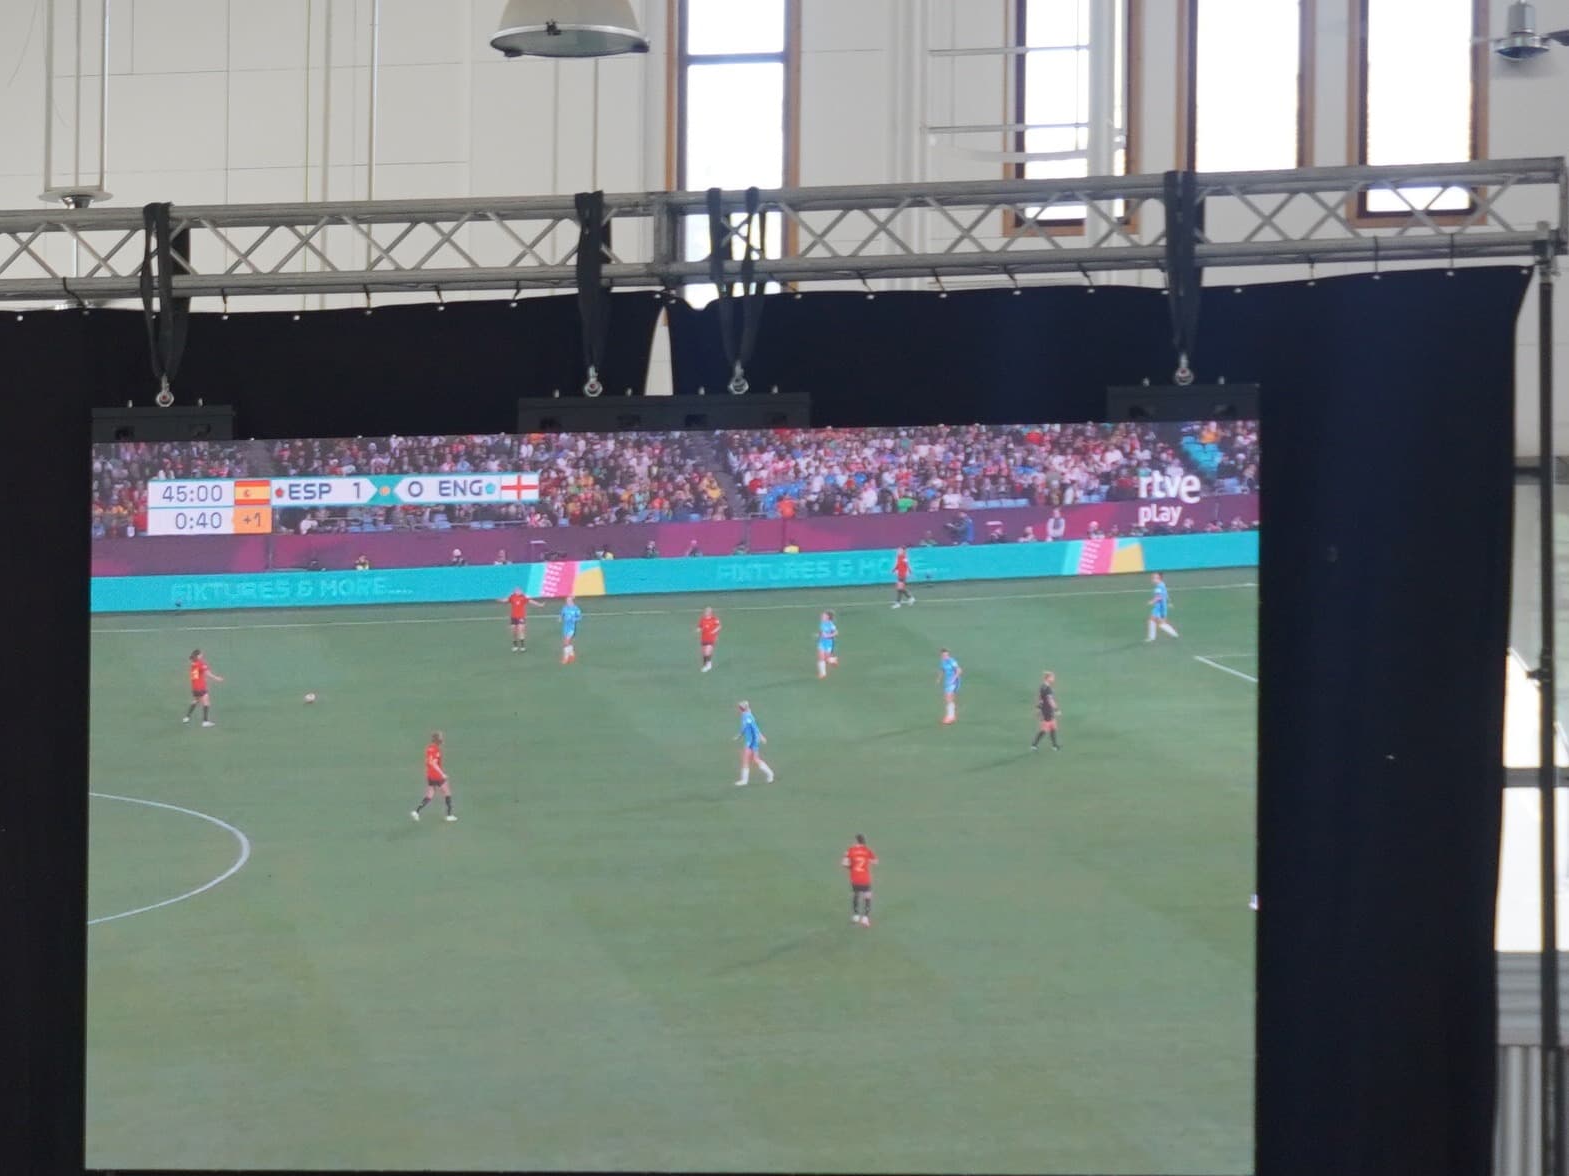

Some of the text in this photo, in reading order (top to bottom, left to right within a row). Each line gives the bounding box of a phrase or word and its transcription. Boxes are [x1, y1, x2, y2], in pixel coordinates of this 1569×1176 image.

[162, 485, 223, 503] 45:00
[288, 482, 332, 500] ESP
[352, 482, 361, 499] 1
[438, 479, 482, 497] ENG
[1139, 470, 1201, 504] rtve
[175, 512, 261, 530] 0:40 +1
[1138, 503, 1183, 527] play
[171, 579, 291, 601] FIXTURES
